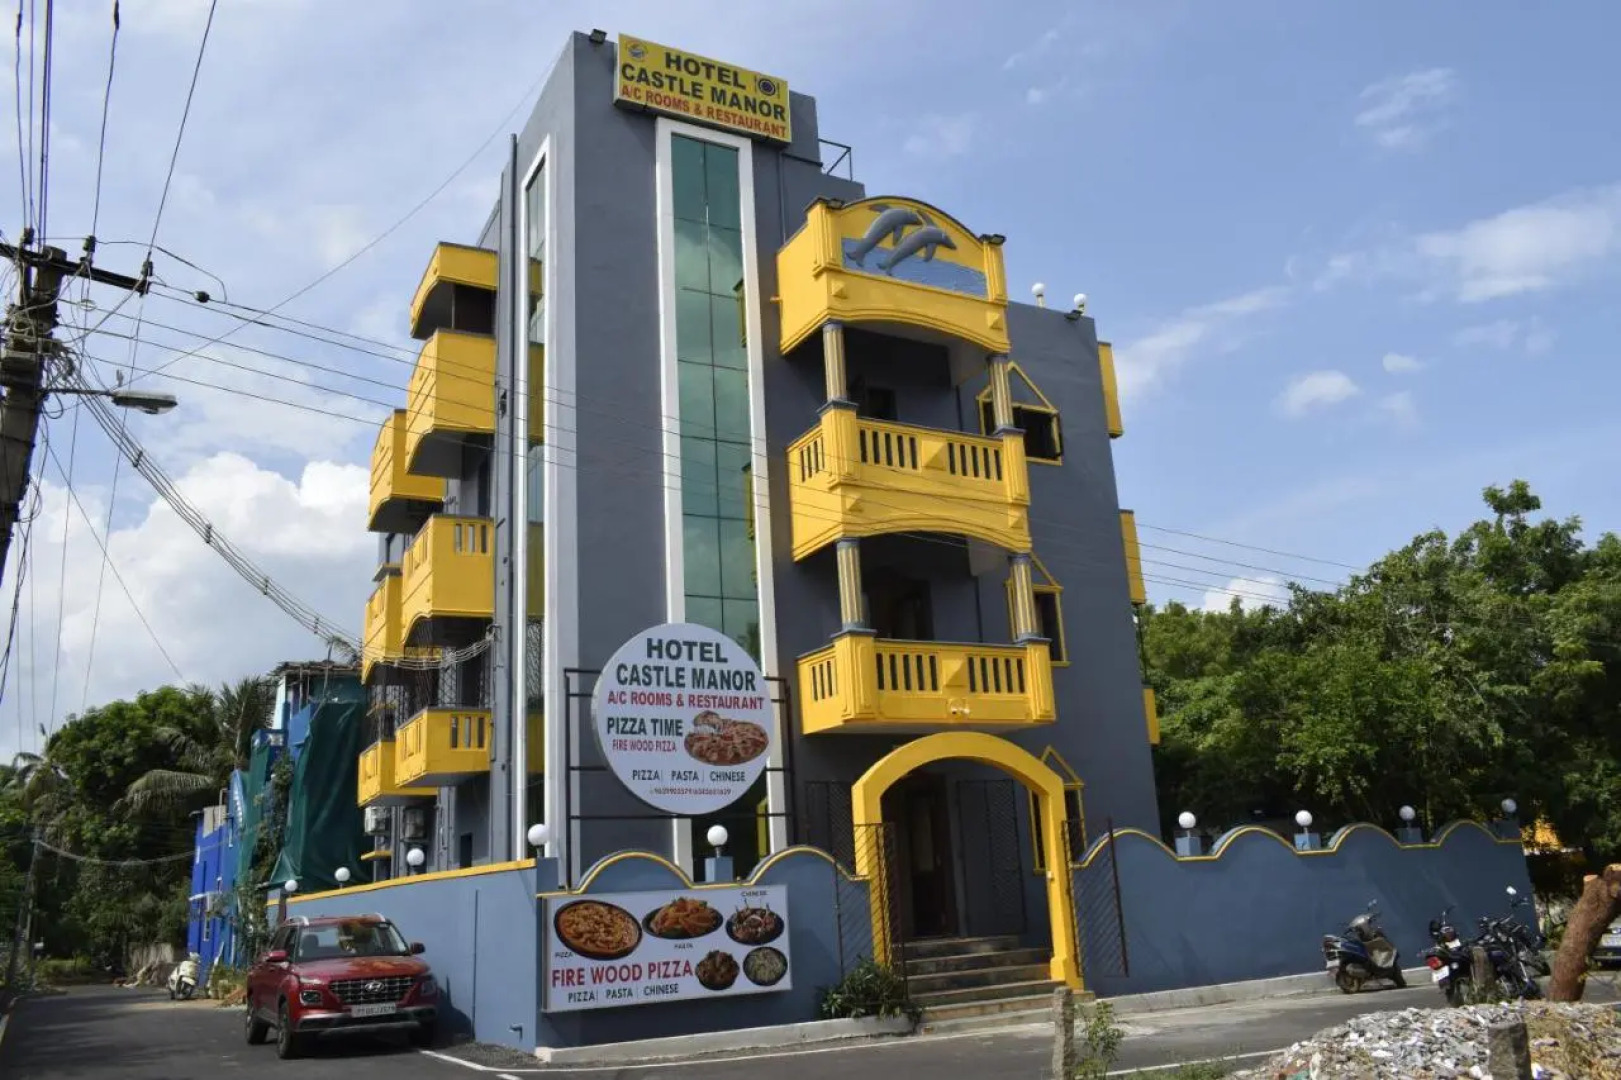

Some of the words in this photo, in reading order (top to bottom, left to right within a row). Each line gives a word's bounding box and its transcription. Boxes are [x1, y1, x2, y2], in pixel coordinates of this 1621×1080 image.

[665, 52, 746, 90] HOTEL
[621, 63, 704, 100] CASTLE
[711, 86, 786, 121] MANOR
[646, 93, 690, 113] ROOMS
[707, 106, 787, 137] RESTAURANT
[646, 637, 728, 663] HOTEL
[616, 663, 686, 688] CASTLE
[692, 668, 756, 691] MANOR
[631, 692, 672, 707] ROOMS
[676, 694, 685, 707] &
[688, 694, 765, 710] RESTAURANT
[607, 717, 647, 735] PIZZA
[650, 718, 683, 737] TIME
[612, 739, 628, 750] FIRE
[629, 739, 654, 751] WOOD
[655, 740, 676, 752] PIZZA
[632, 769, 660, 781] PIZZA
[671, 770, 699, 782] PASTA
[709, 771, 746, 782] CHINESE
[552, 968, 585, 987] FIRE
[590, 964, 643, 984] WOOD
[648, 960, 693, 980] PIZZA
[568, 990, 595, 1003] PIZZA
[605, 987, 633, 999] PASTA
[643, 983, 679, 996] CHINESE
